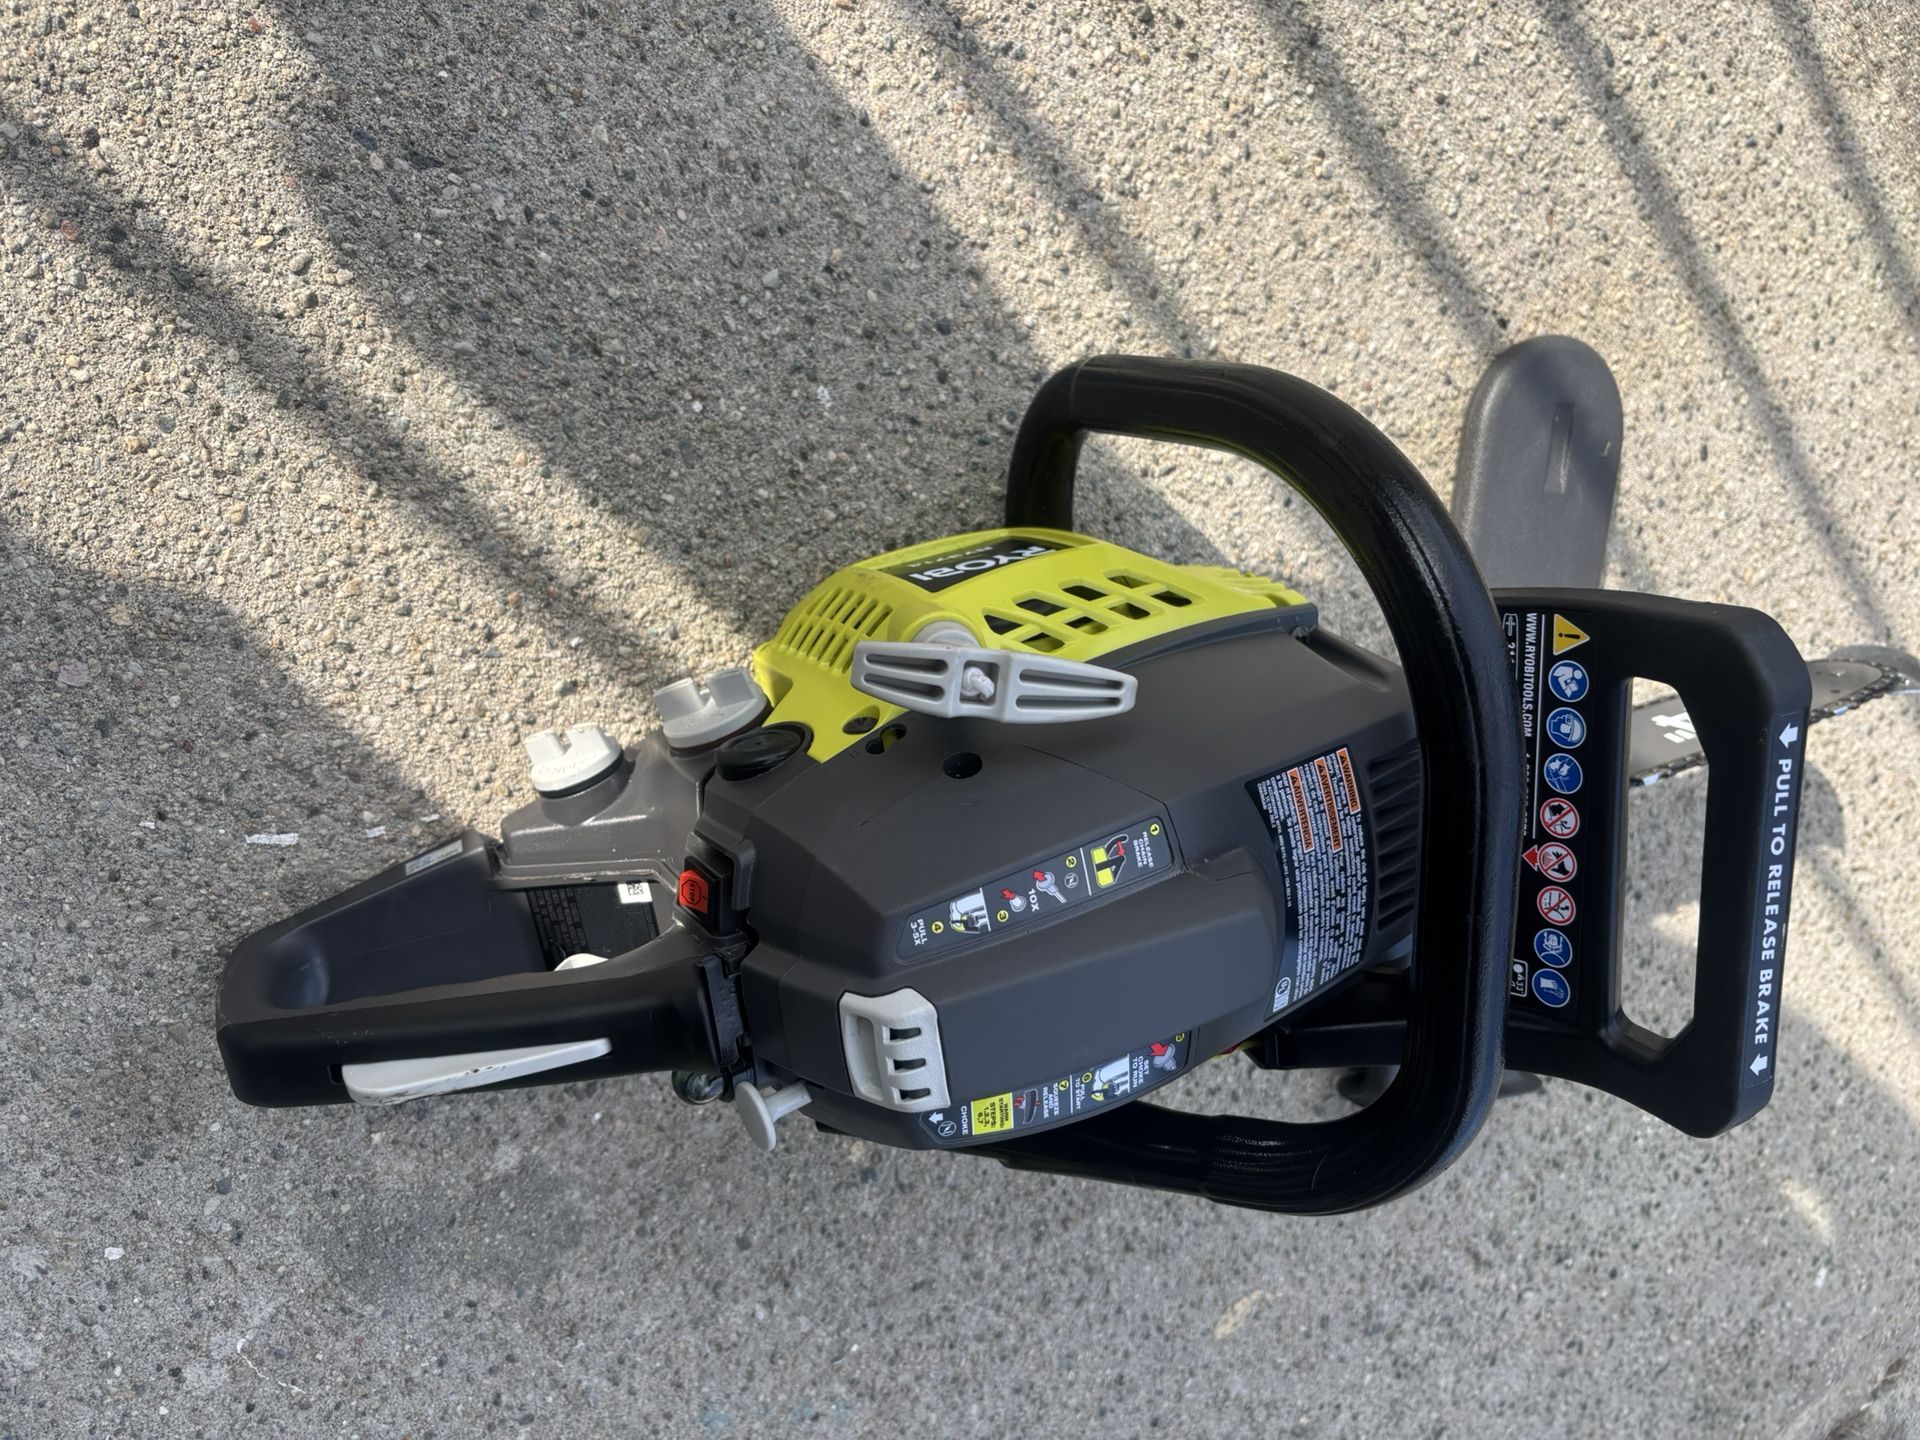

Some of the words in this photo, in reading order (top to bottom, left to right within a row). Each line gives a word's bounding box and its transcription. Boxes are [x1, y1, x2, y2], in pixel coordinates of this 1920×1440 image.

[908, 546, 1056, 582] RYOBI
[1522, 612, 1537, 737] WWW.RYOBITOOLS.COM
[1304, 764, 1314, 789] respect
[1343, 764, 1357, 808] WARNING
[1773, 758, 1793, 817] PULL
[1293, 785, 1313, 848] ADVERTENCIA
[1321, 774, 1341, 847] AVERTISSEMENT
[1133, 839, 1143, 868] BRAKE
[1138, 838, 1147, 865] CHAIN
[1143, 832, 1154, 868] RELEASE
[1770, 824, 1787, 856] TO
[1028, 888, 1040, 912] 10X
[1760, 864, 1782, 960] RELEASE
[910, 922, 921, 946] 3-5X
[917, 919, 927, 944] PULL
[1754, 969, 1772, 1044] BRAKE
[1132, 1057, 1138, 1069] TO
[1075, 1078, 1080, 1088] TO
